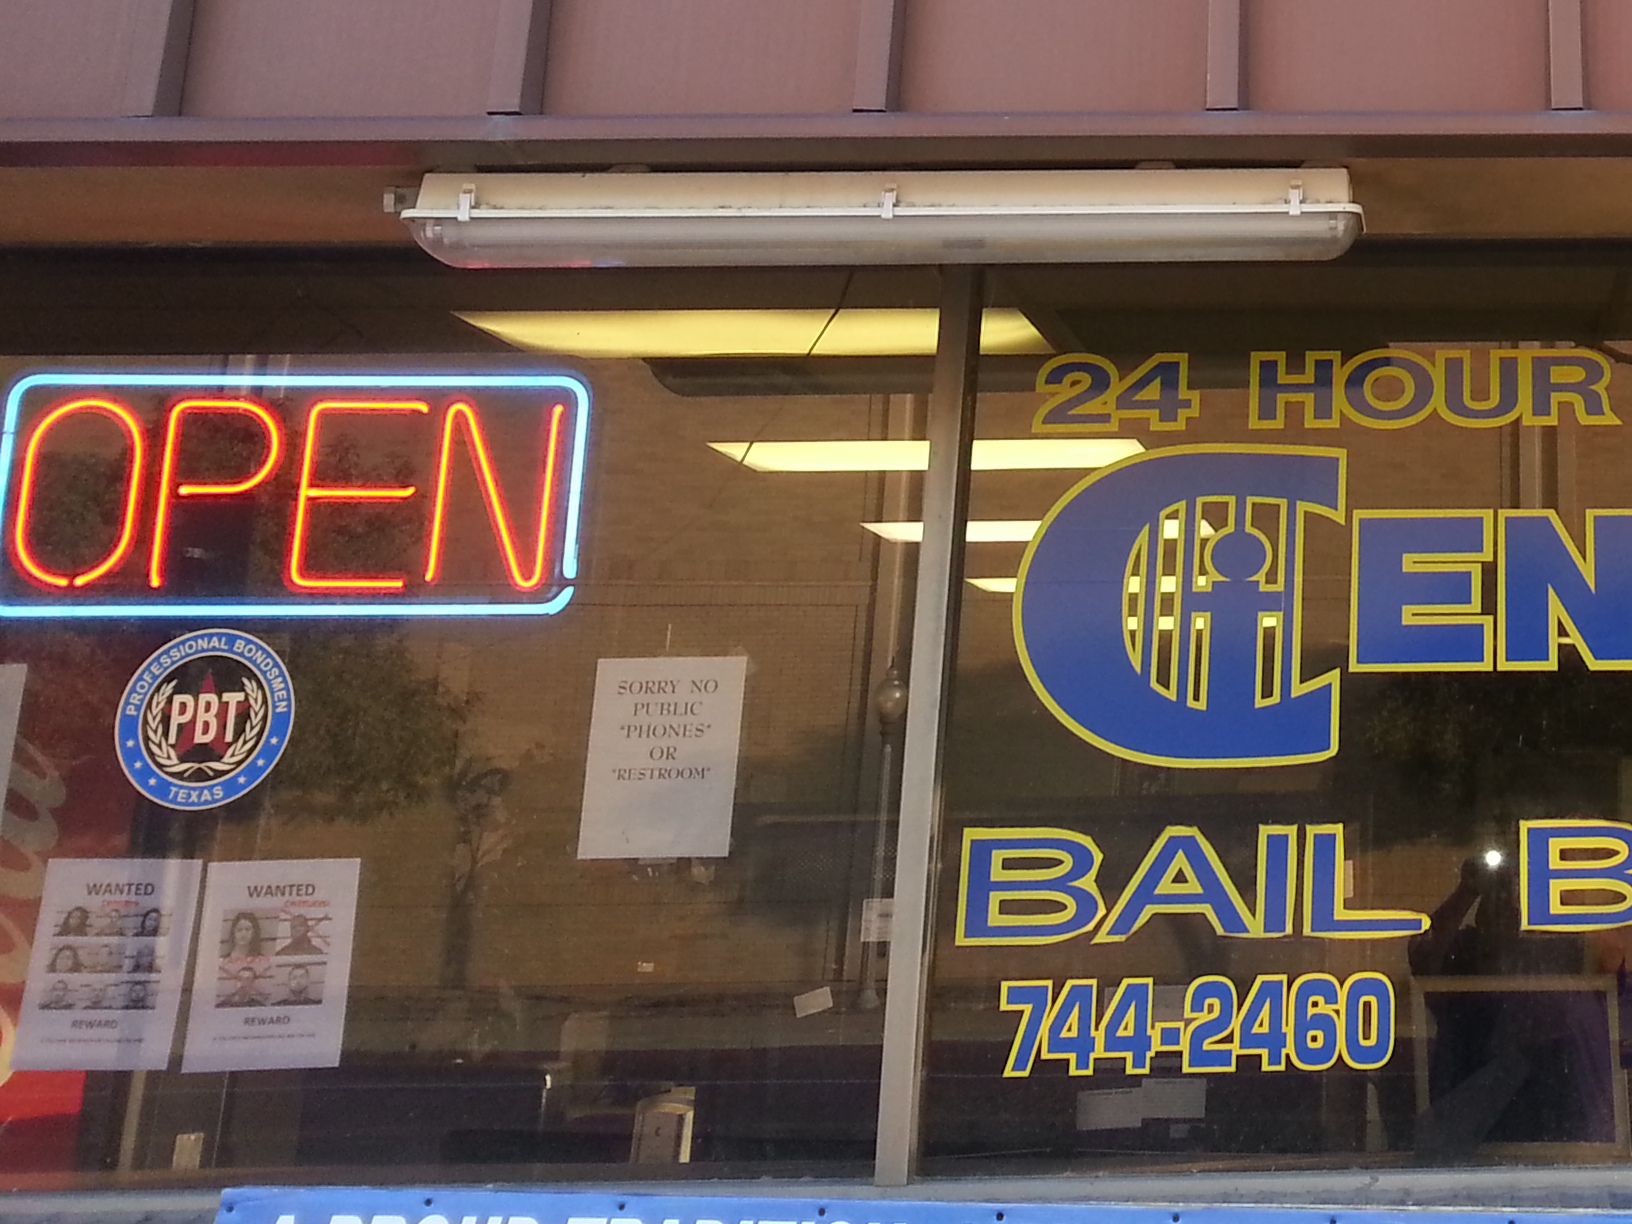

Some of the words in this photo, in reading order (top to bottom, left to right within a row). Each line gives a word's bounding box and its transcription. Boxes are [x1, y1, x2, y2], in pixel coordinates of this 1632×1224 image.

[1032, 351, 1200, 433] 24
[1247, 349, 1622, 429] HOUR
[10, 396, 567, 591] OPEN
[125, 636, 229, 717] PROFESSIONAL
[232, 638, 289, 714] BONDSMEN
[617, 679, 681, 696] SORRY
[690, 678, 719, 694] NO
[632, 700, 703, 717] PUBLIC
[167, 691, 246, 746] PBT
[648, 745, 678, 761] OR
[168, 785, 225, 804] TEXAS
[86, 882, 156, 897] WANTED
[247, 883, 316, 898] WANTED
[956, 823, 1431, 946] BAIL
[70, 1019, 119, 1030] REWARD
[243, 1015, 291, 1027] REWARD
[999, 971, 1396, 1079] 744-2460
